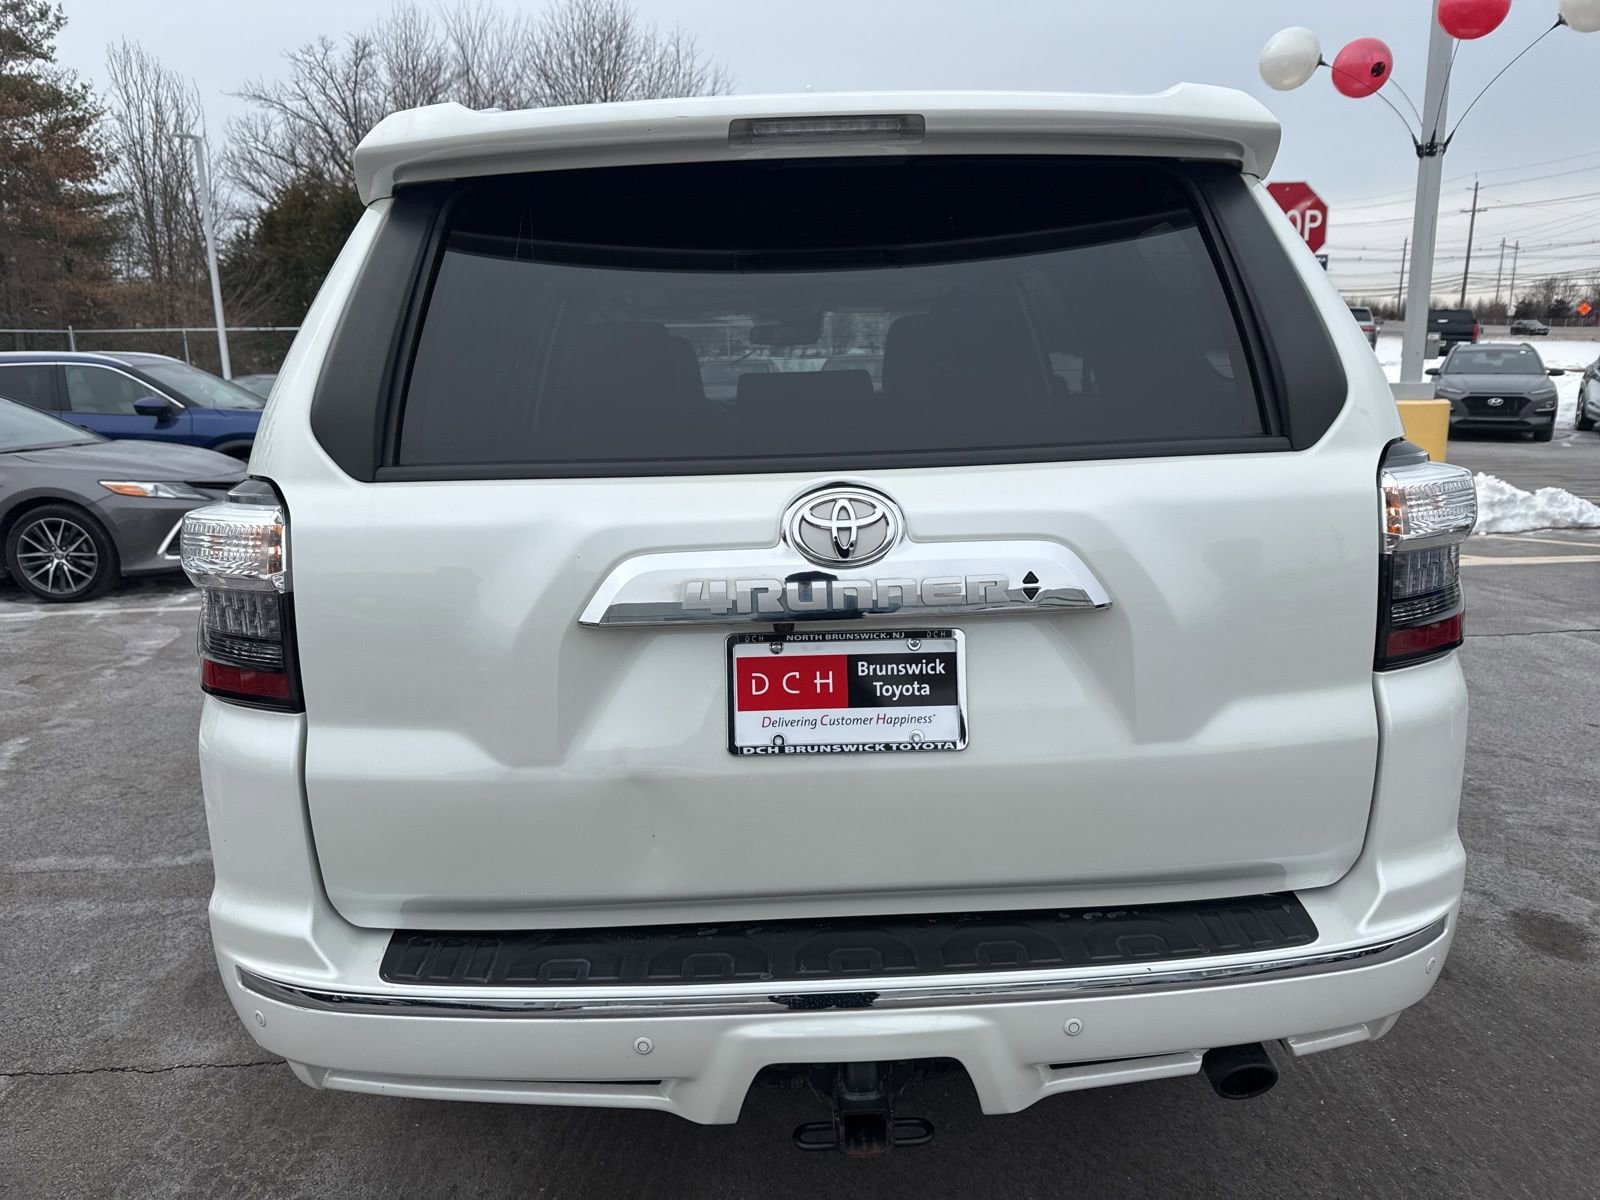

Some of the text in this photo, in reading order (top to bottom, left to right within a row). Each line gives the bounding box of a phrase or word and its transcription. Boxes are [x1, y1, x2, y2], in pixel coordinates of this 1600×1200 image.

[1286, 209, 1323, 242] OP
[892, 631, 905, 639] NJ
[857, 658, 946, 676] Brunswick
[872, 681, 930, 701] Toyota
[761, 716, 818, 730] Delivering
[820, 714, 874, 726] Customer
[743, 742, 955, 755] DCH BRUNSWICK TOYOTA
